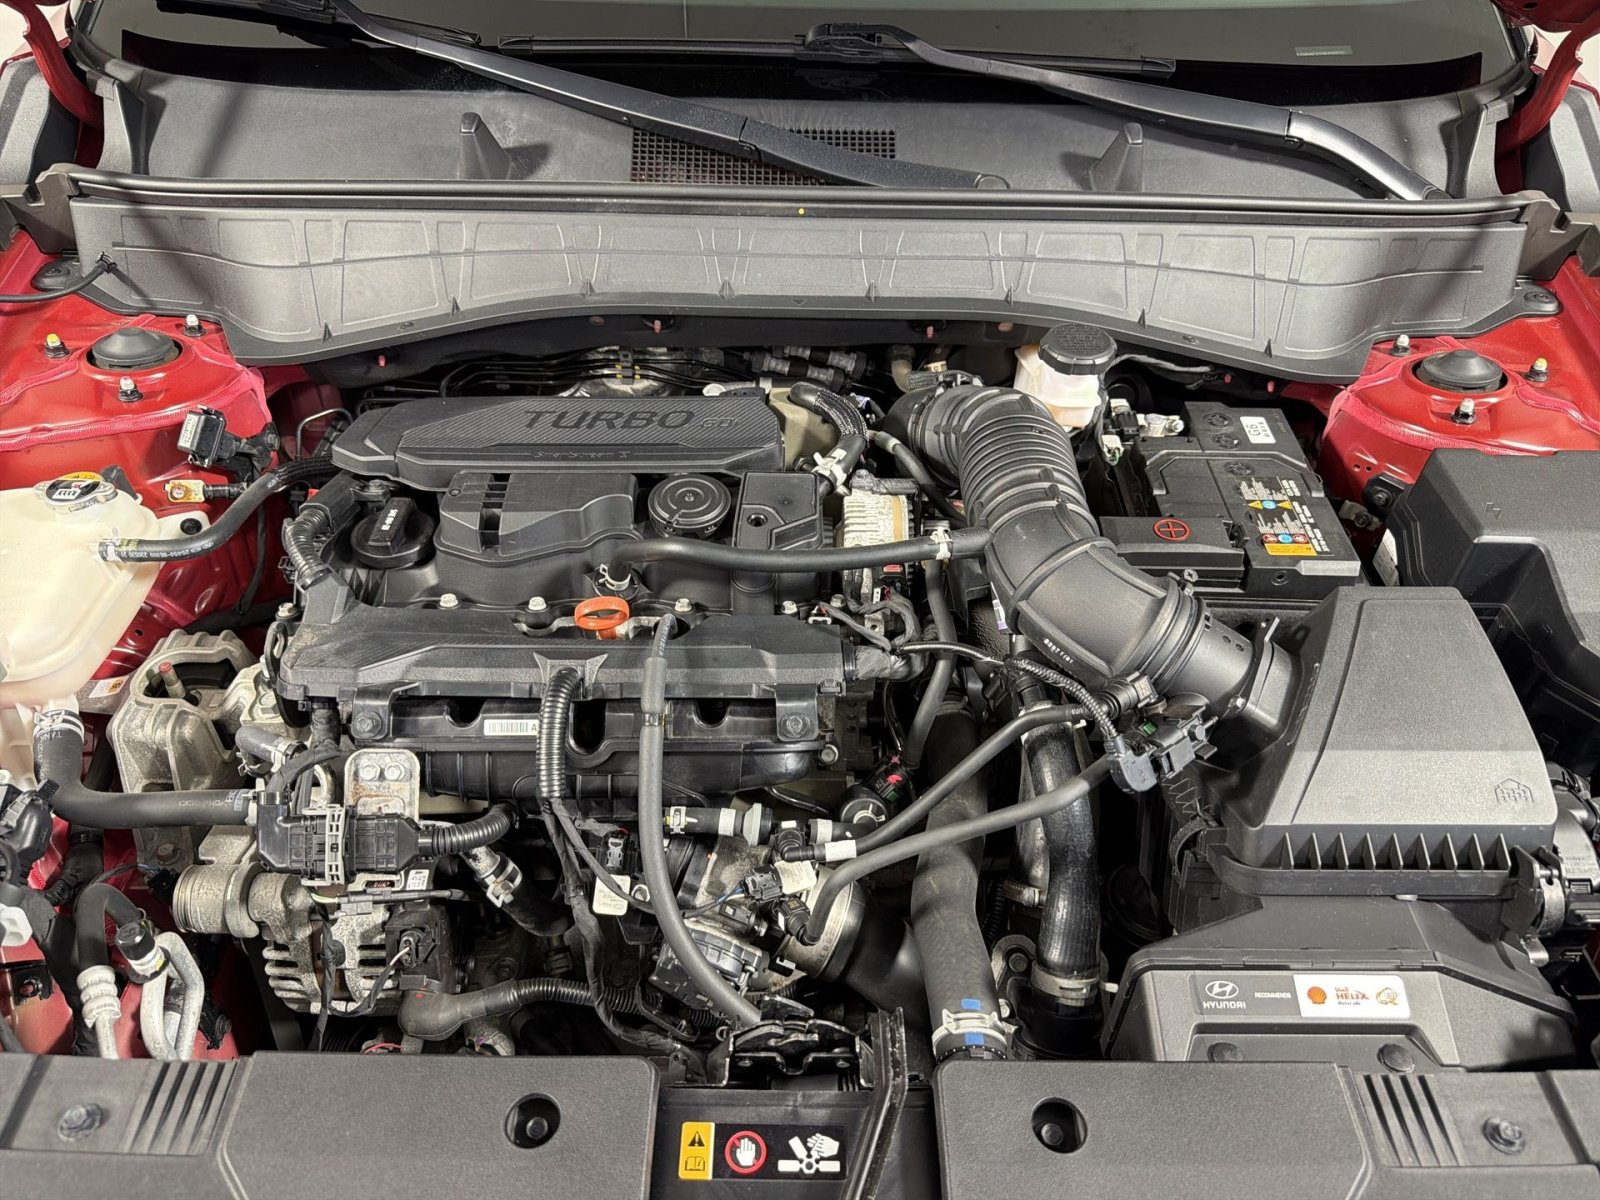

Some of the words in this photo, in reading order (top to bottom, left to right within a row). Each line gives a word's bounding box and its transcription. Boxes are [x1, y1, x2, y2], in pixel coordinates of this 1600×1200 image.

[525, 410, 695, 429] TURBO
[531, 723, 537, 731] A
[1336, 992, 1368, 1000] HELIX
[1203, 1000, 1246, 1009] HYUNDAI
